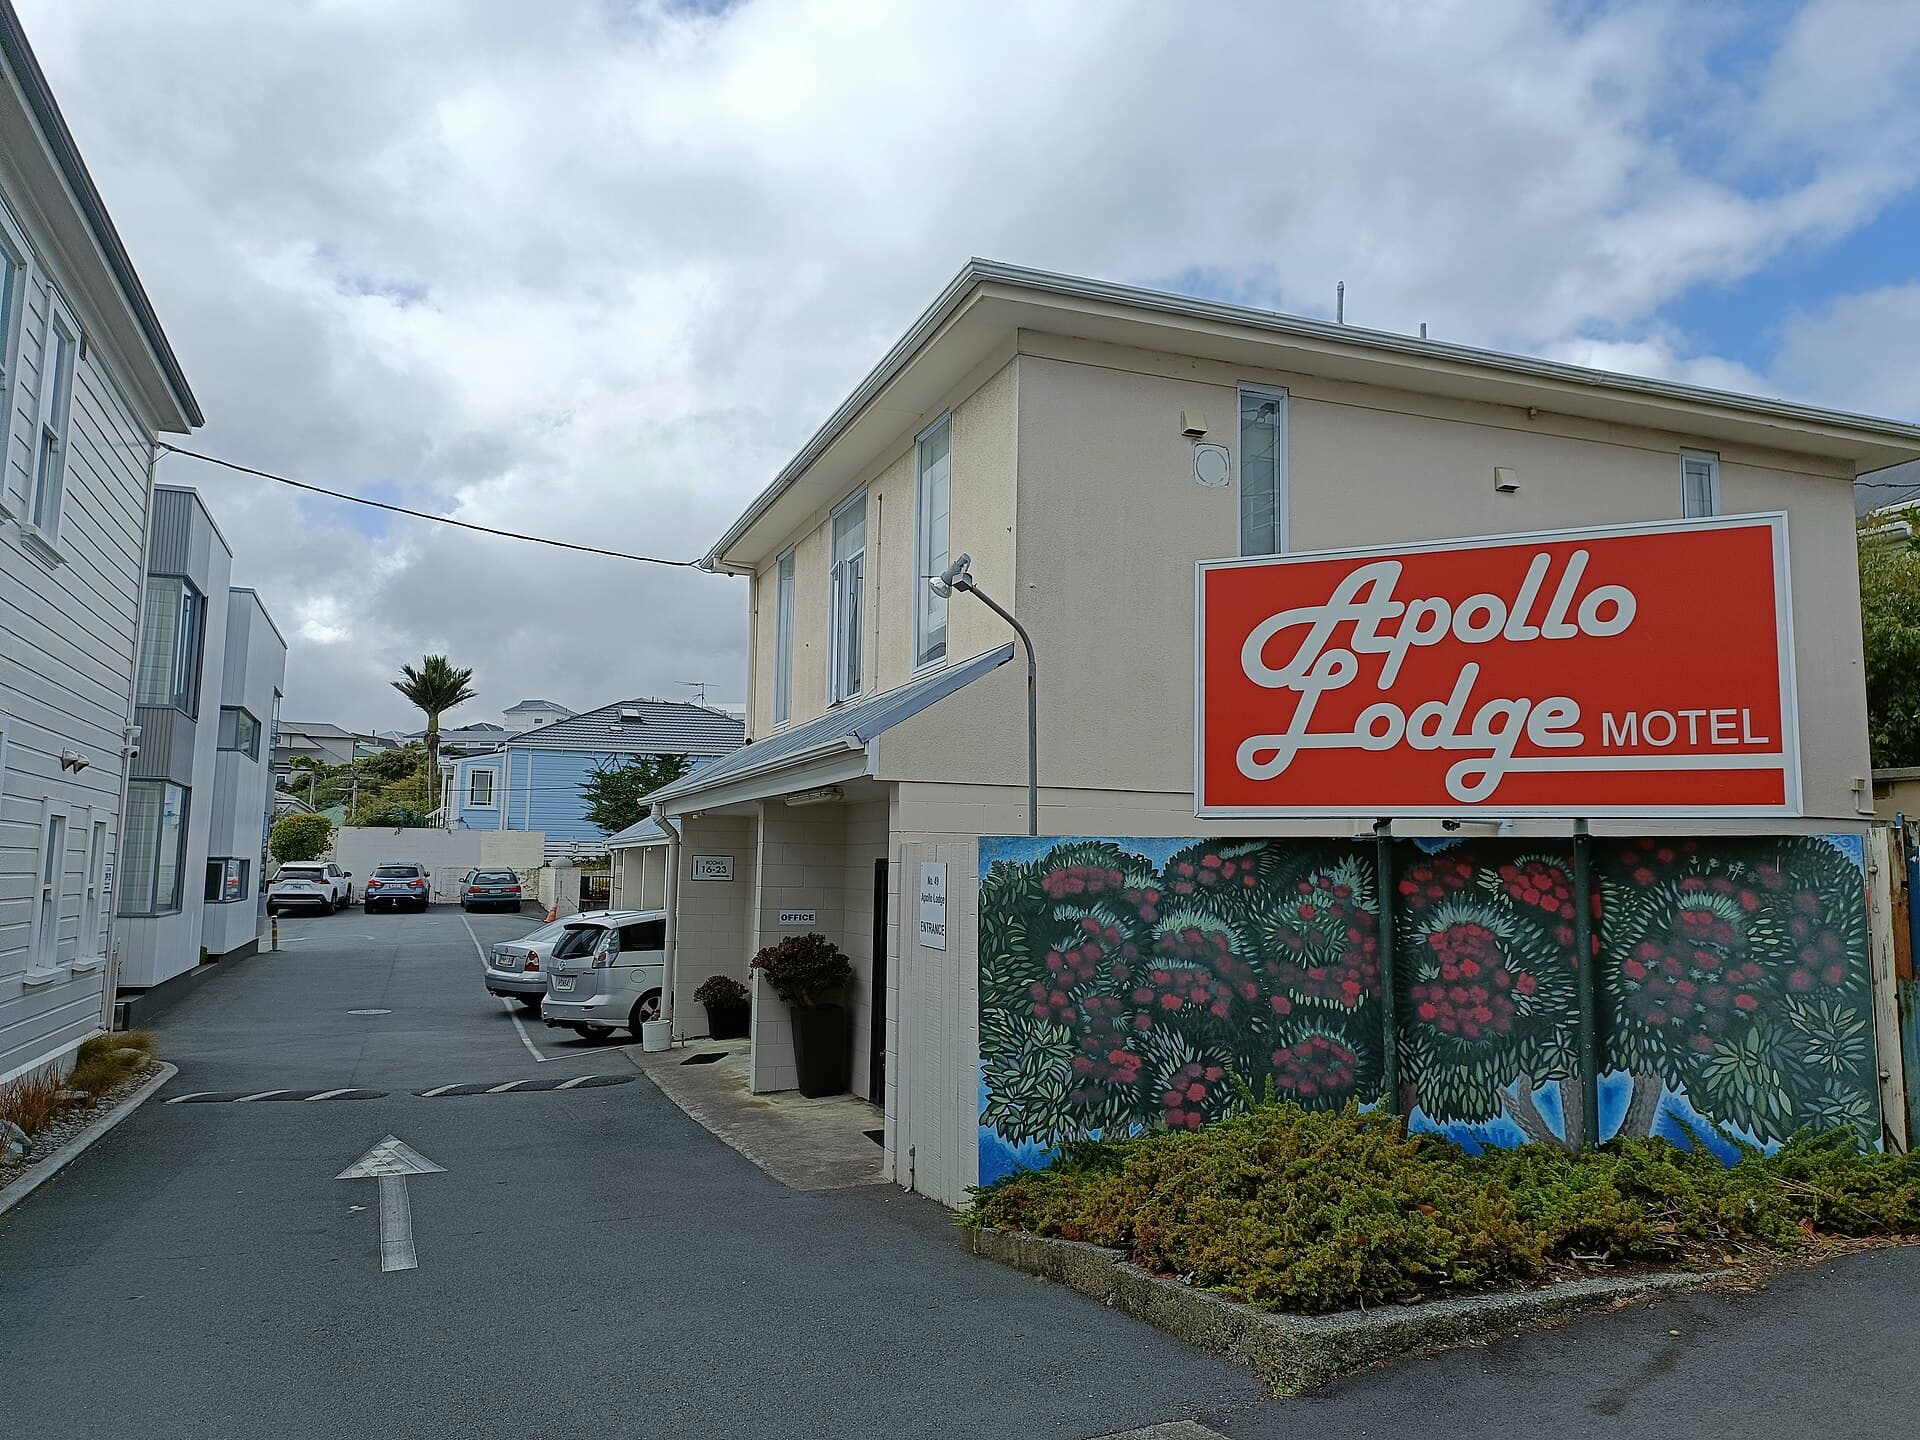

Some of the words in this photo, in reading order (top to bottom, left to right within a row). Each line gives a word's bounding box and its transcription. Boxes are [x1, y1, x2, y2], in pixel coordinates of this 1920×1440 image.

[1240, 549, 1638, 690] Apollo
[1236, 648, 1585, 803] Lodge
[1601, 707, 1770, 748] MOTEL
[701, 865, 727, 874] 16-23
[921, 892, 932, 904] Apollo
[933, 893, 945, 907] Lodge
[780, 913, 815, 922] OFFICE
[920, 921, 945, 937] ENTRANCE
